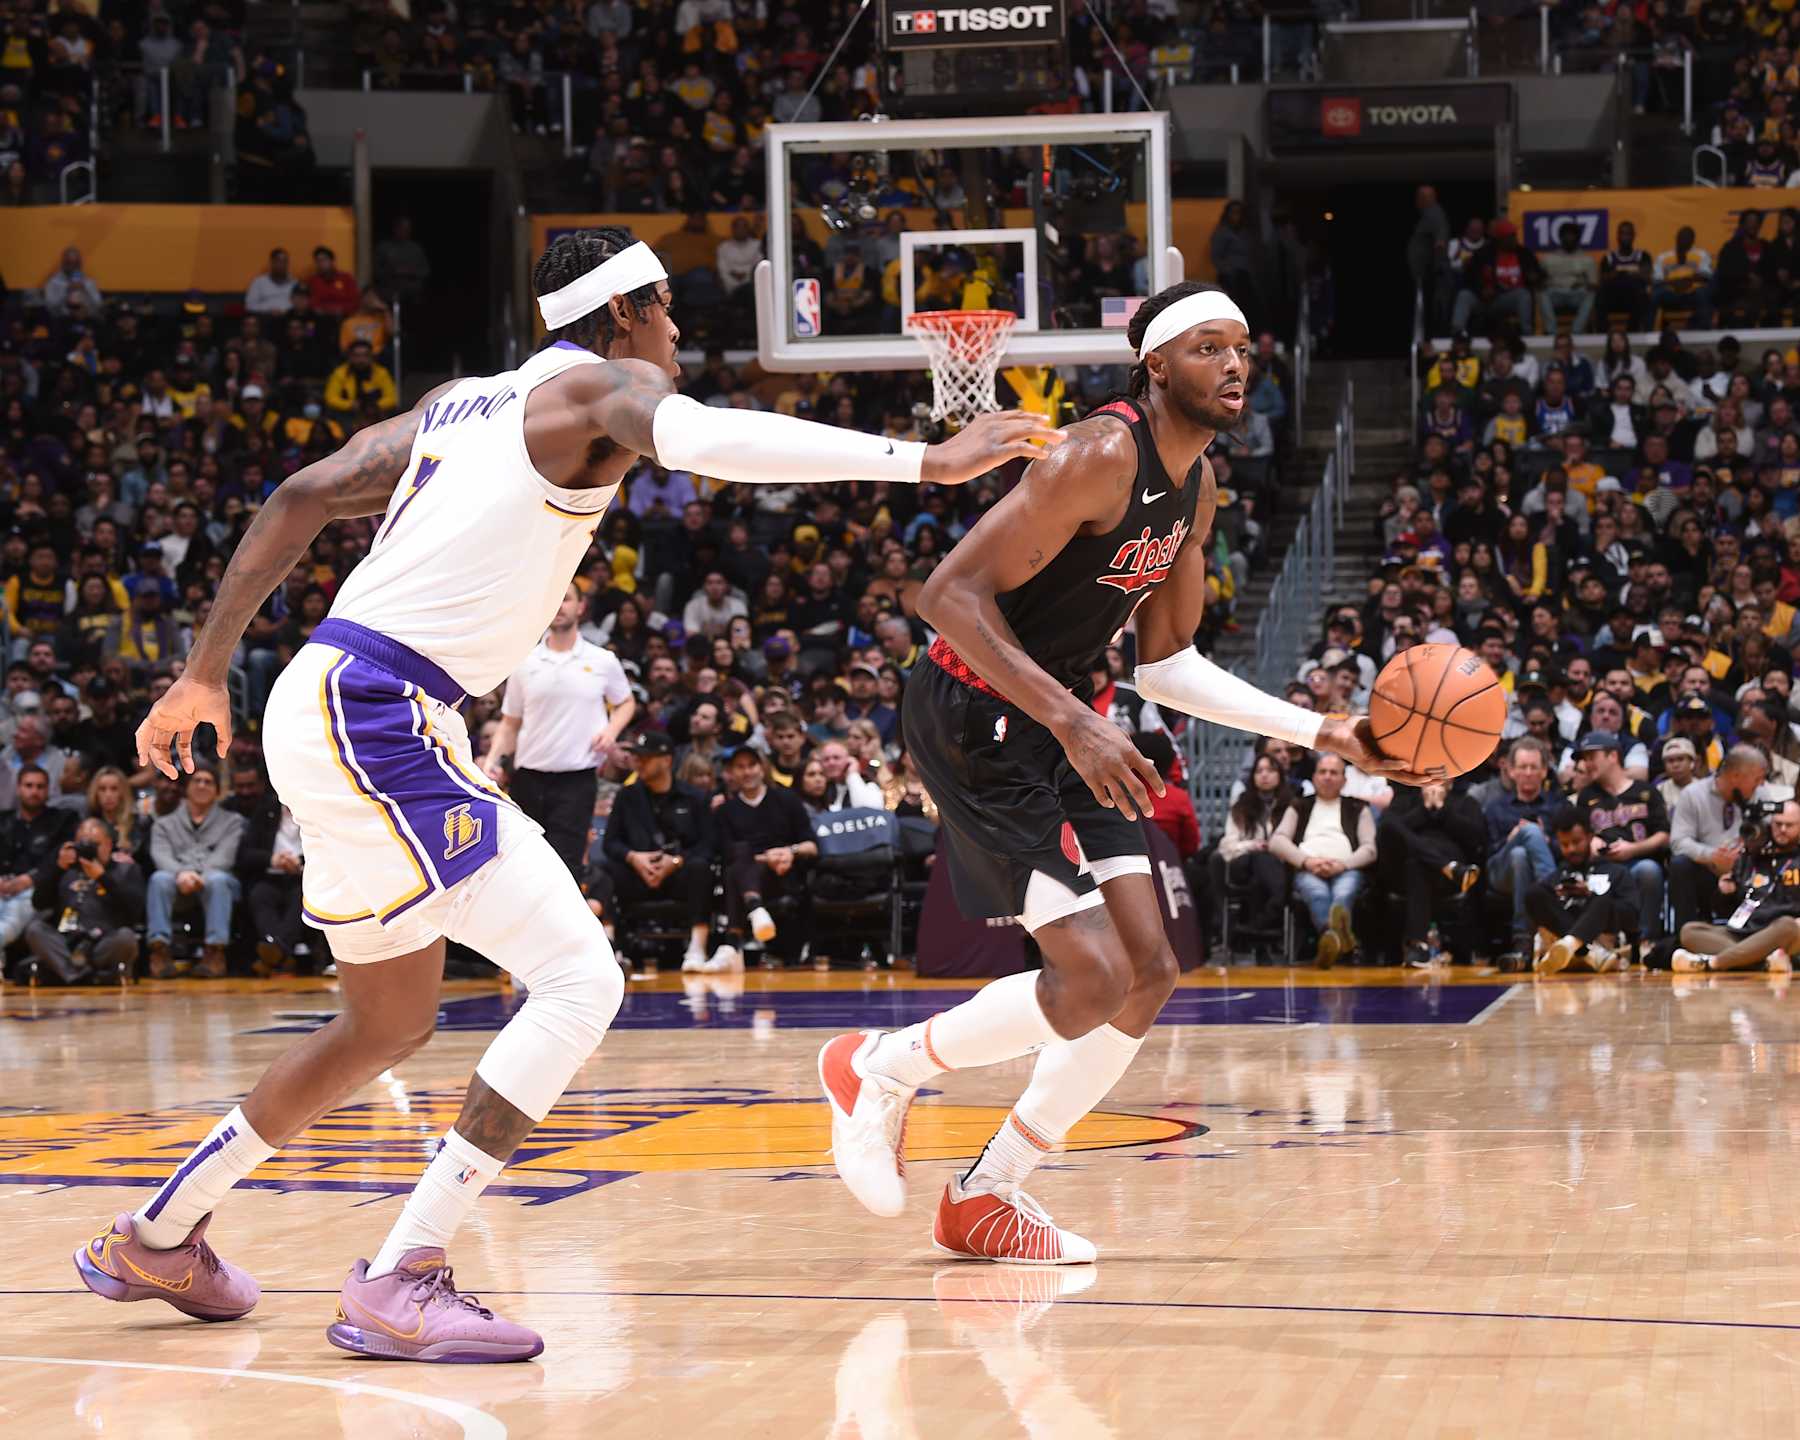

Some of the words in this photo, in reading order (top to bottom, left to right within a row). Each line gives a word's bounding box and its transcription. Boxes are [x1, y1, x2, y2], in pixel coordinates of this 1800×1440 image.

[937, 5, 1053, 32] TISSOT
[1368, 104, 1457, 126] TOYOTA
[832, 815, 887, 835] DELTA
